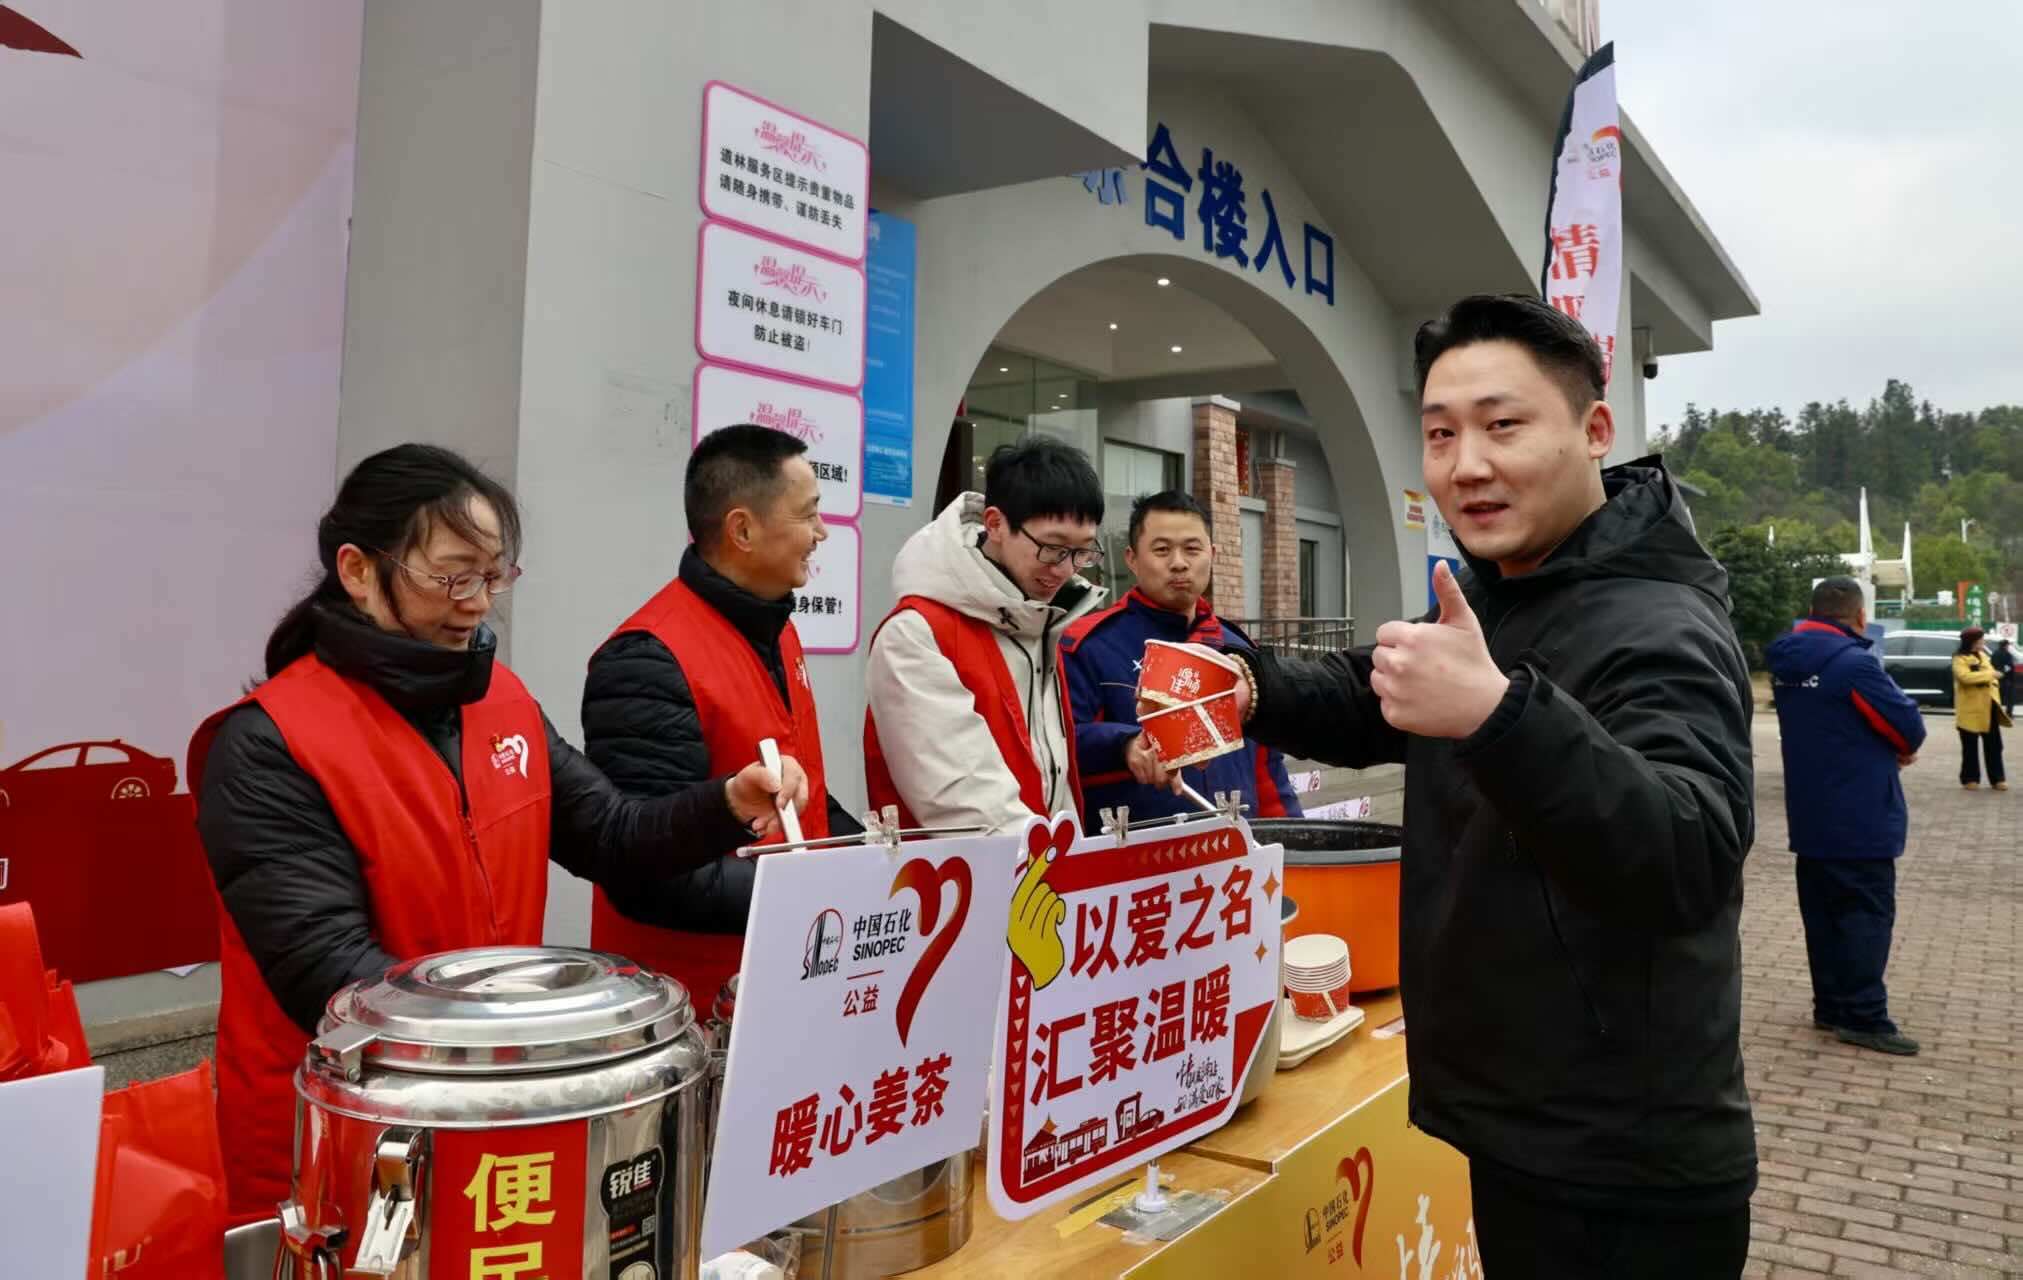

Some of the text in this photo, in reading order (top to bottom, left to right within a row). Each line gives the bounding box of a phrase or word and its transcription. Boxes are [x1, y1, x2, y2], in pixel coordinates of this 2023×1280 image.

[728, 290, 842, 336] 夜间休息请锁好车门
[793, 595, 842, 614] 身保管!
[852, 908, 911, 940] 中国石化
[1070, 865, 1253, 979] 以爱之名
[852, 935, 906, 961] SINOPEC
[843, 984, 879, 1016] 公益
[1031, 964, 1231, 1105] 汇聚温暖
[768, 1053, 952, 1178] 暖心姜茶
